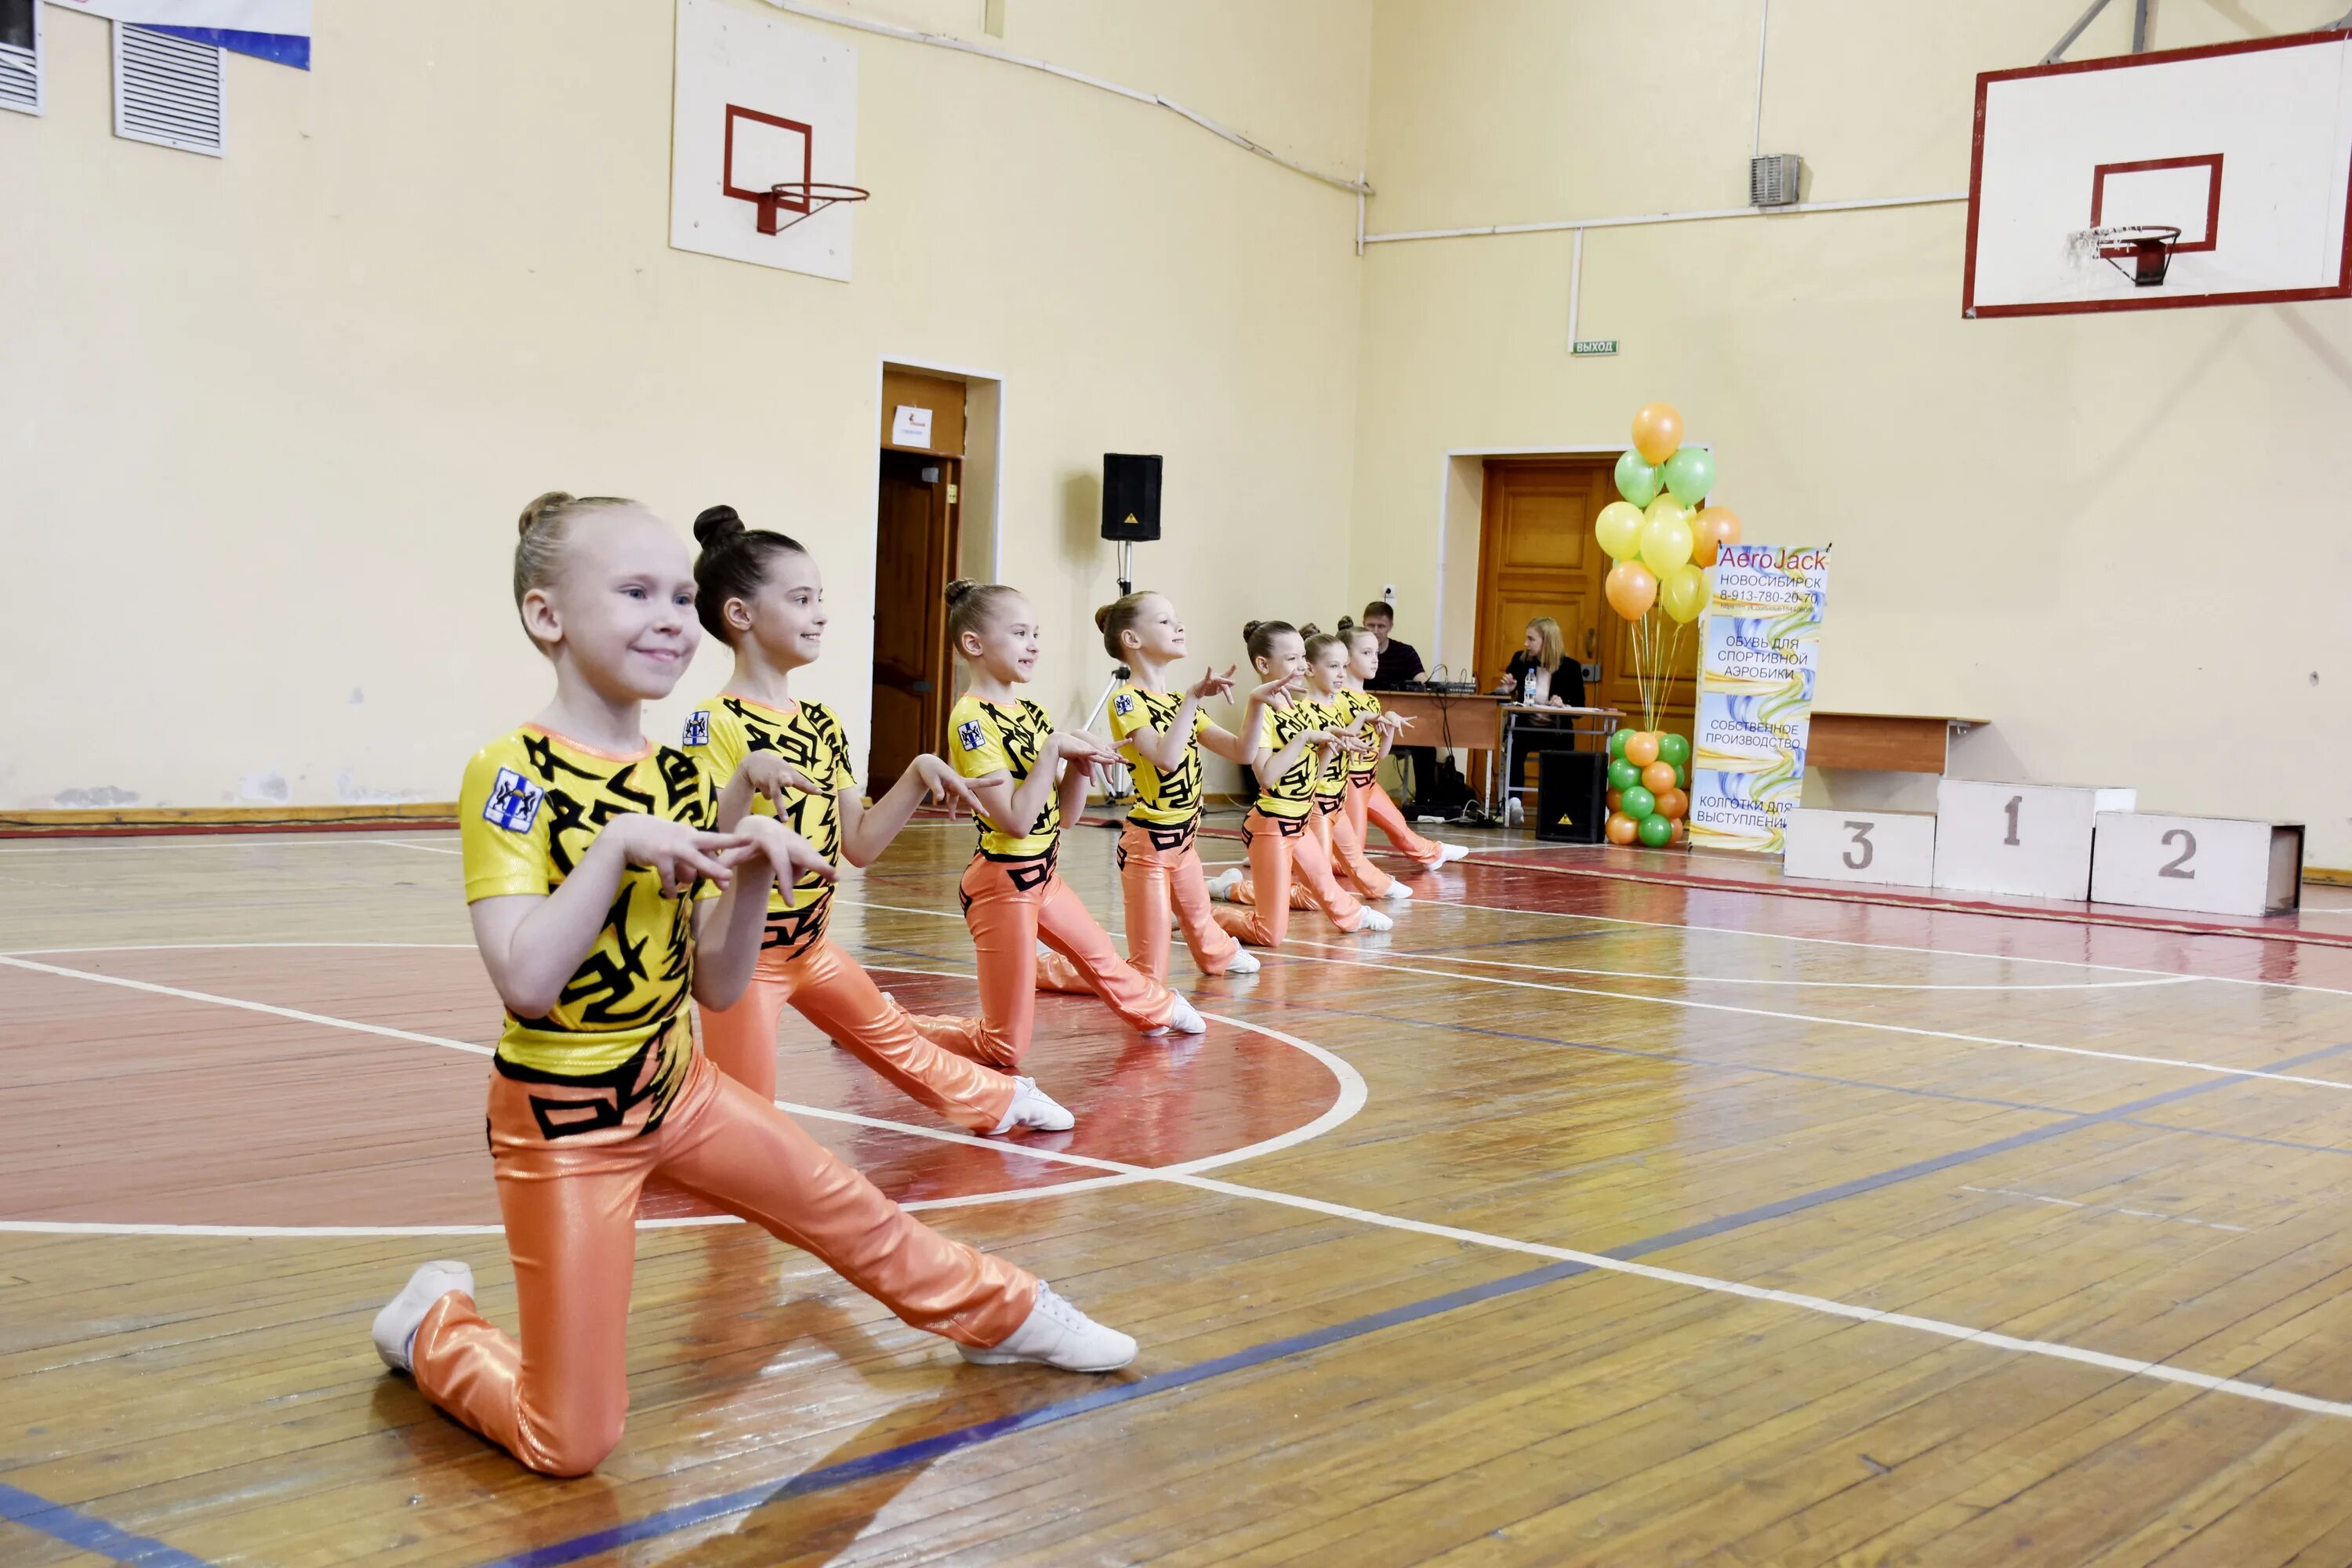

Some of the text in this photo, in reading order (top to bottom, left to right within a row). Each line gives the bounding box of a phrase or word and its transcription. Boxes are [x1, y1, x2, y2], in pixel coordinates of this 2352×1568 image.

[1577, 342, 1613, 353] ВЫХОД
[1719, 547, 1826, 570] AeroJack
[1720, 575, 1822, 588] НОВОСИБИРСК
[1720, 590, 1818, 604] 8-913-780-20-70
[1726, 636, 1799, 650] ОБУВЬ ДЛЯ
[1718, 651, 1808, 665] СПОРТИВНОЙ
[1724, 666, 1795, 680] АЭРОБИКИ
[1711, 719, 1798, 735] СОБСТВЕННОЕ
[1705, 733, 1801, 749] ПРОИЗВОДСТВО
[1700, 796, 1793, 814] КОЛГОТКИ ДЛЯ
[2004, 796, 2022, 846] 1
[1842, 821, 1875, 869] 3
[2158, 829, 2197, 880] 2
